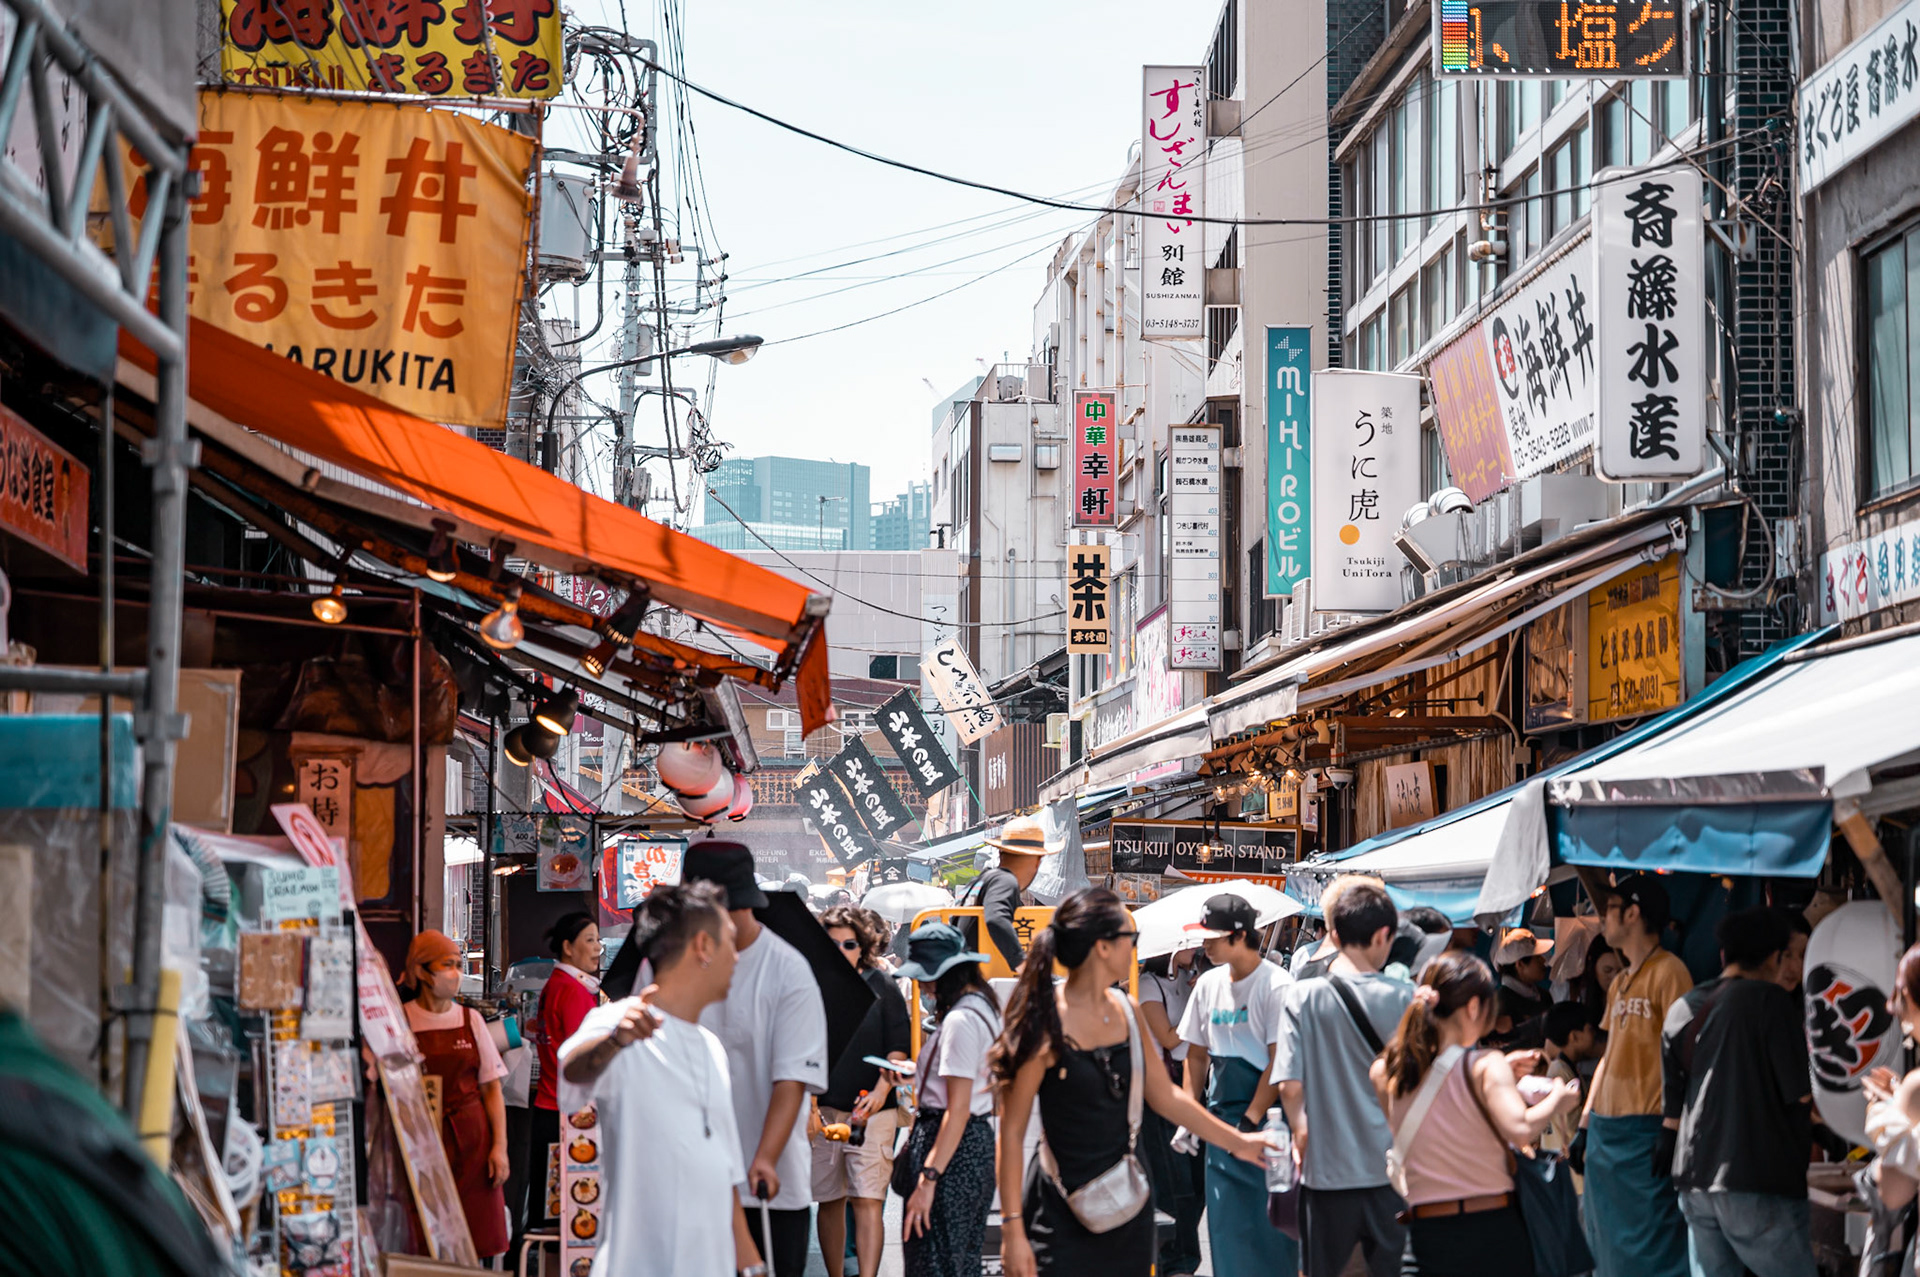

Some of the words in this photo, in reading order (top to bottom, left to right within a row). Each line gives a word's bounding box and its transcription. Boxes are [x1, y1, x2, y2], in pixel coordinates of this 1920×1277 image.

[366, 51, 551, 95] まるきた
[1804, 63, 1860, 165] まぐろ屋
[1150, 79, 1196, 235] すしざんまい
[1160, 244, 1185, 286] 別館
[1145, 318, 1200, 329] 03-5148-3737
[1380, 406, 1393, 435] 築地
[1508, 401, 1531, 442] 築地
[1514, 422, 1571, 469] 03-3543-5228
[1082, 400, 1110, 515] 中華幸軒
[1277, 366, 1305, 578] MIHIROビル
[1348, 410, 1380, 522] うに虎
[1207, 507, 1217, 515] 403
[1070, 553, 1108, 621] 茶
[1342, 568, 1393, 578] UniTora
[1346, 557, 1385, 568] Tsukiji
[1826, 552, 1868, 612] まぐろ
[888, 710, 944, 786] 山本の豆
[845, 757, 895, 830] 山本の豆
[810, 788, 863, 860] 山本の豆
[1114, 839, 1169, 859] TSUKIJI
[1238, 844, 1287, 860] STAND
